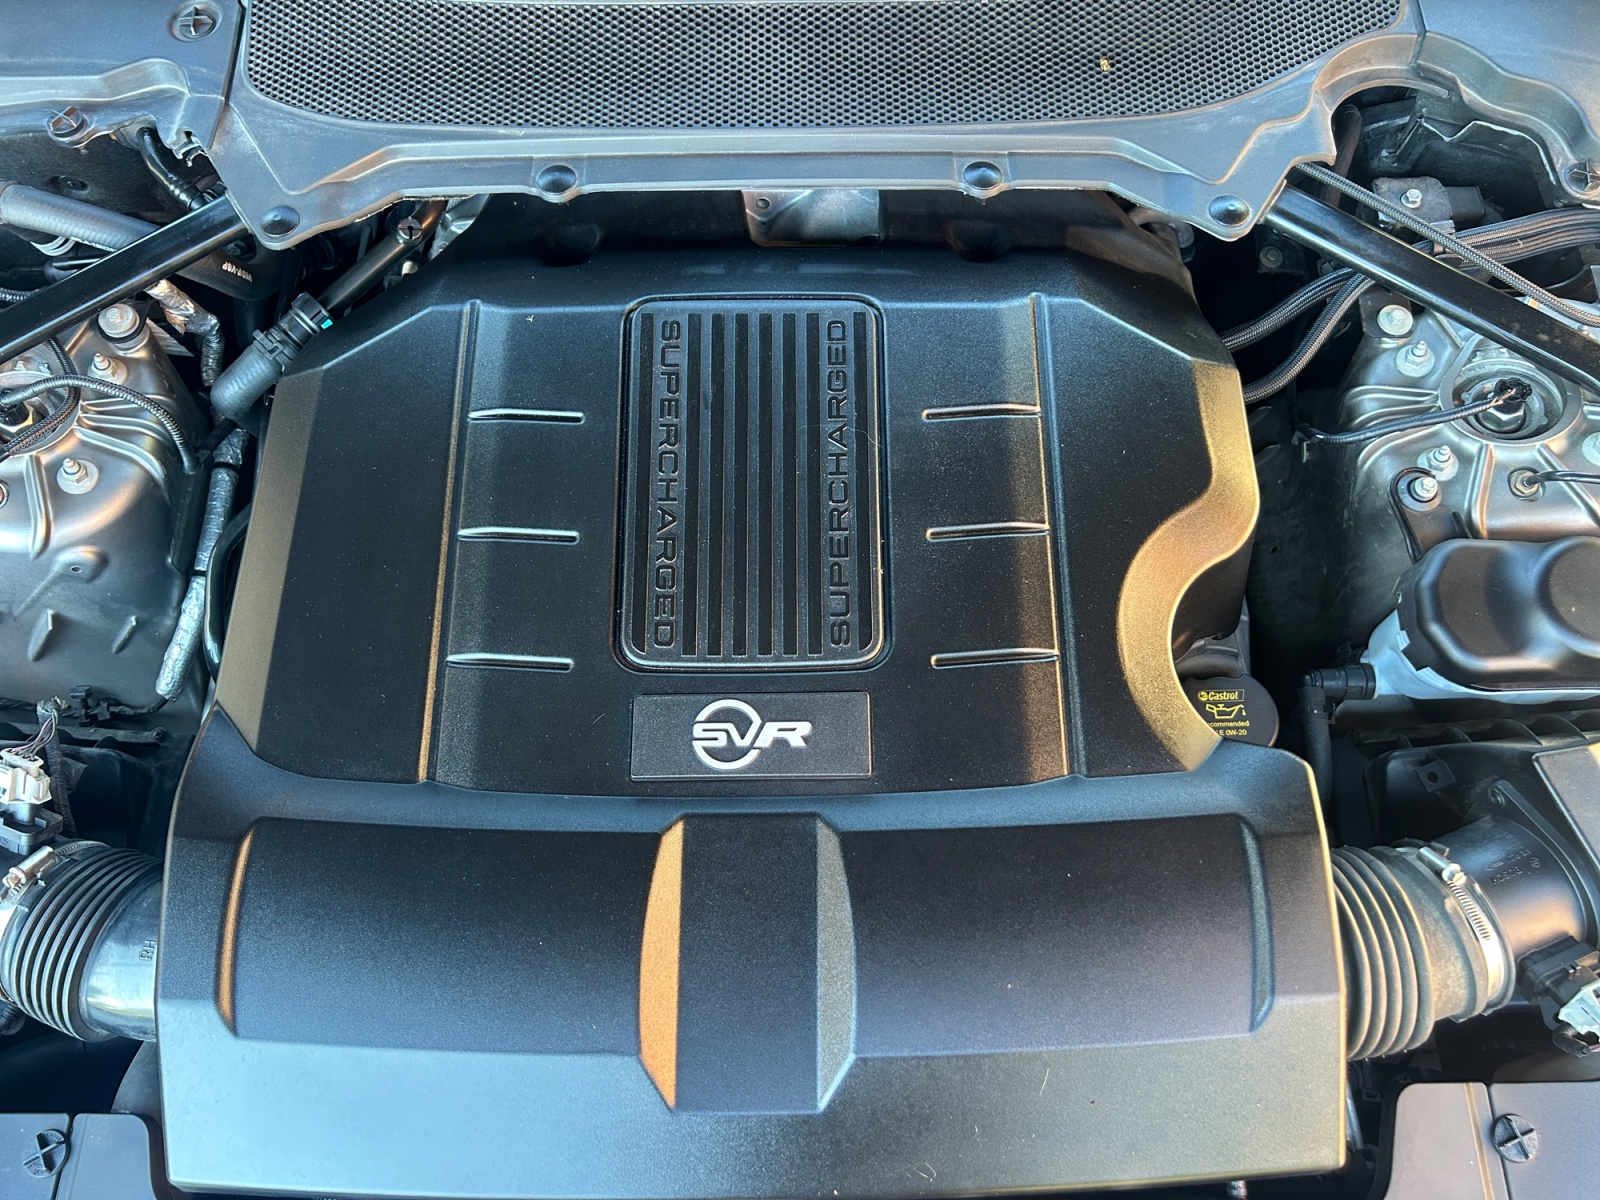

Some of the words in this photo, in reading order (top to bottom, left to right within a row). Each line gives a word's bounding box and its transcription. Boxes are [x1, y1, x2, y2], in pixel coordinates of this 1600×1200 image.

[653, 319, 681, 648] SUPERCHARGED
[827, 319, 850, 647] SUPERCHARGED
[1209, 691, 1238, 700] Castrol
[692, 699, 812, 769] SVR
[140, 940, 156, 961] RH
